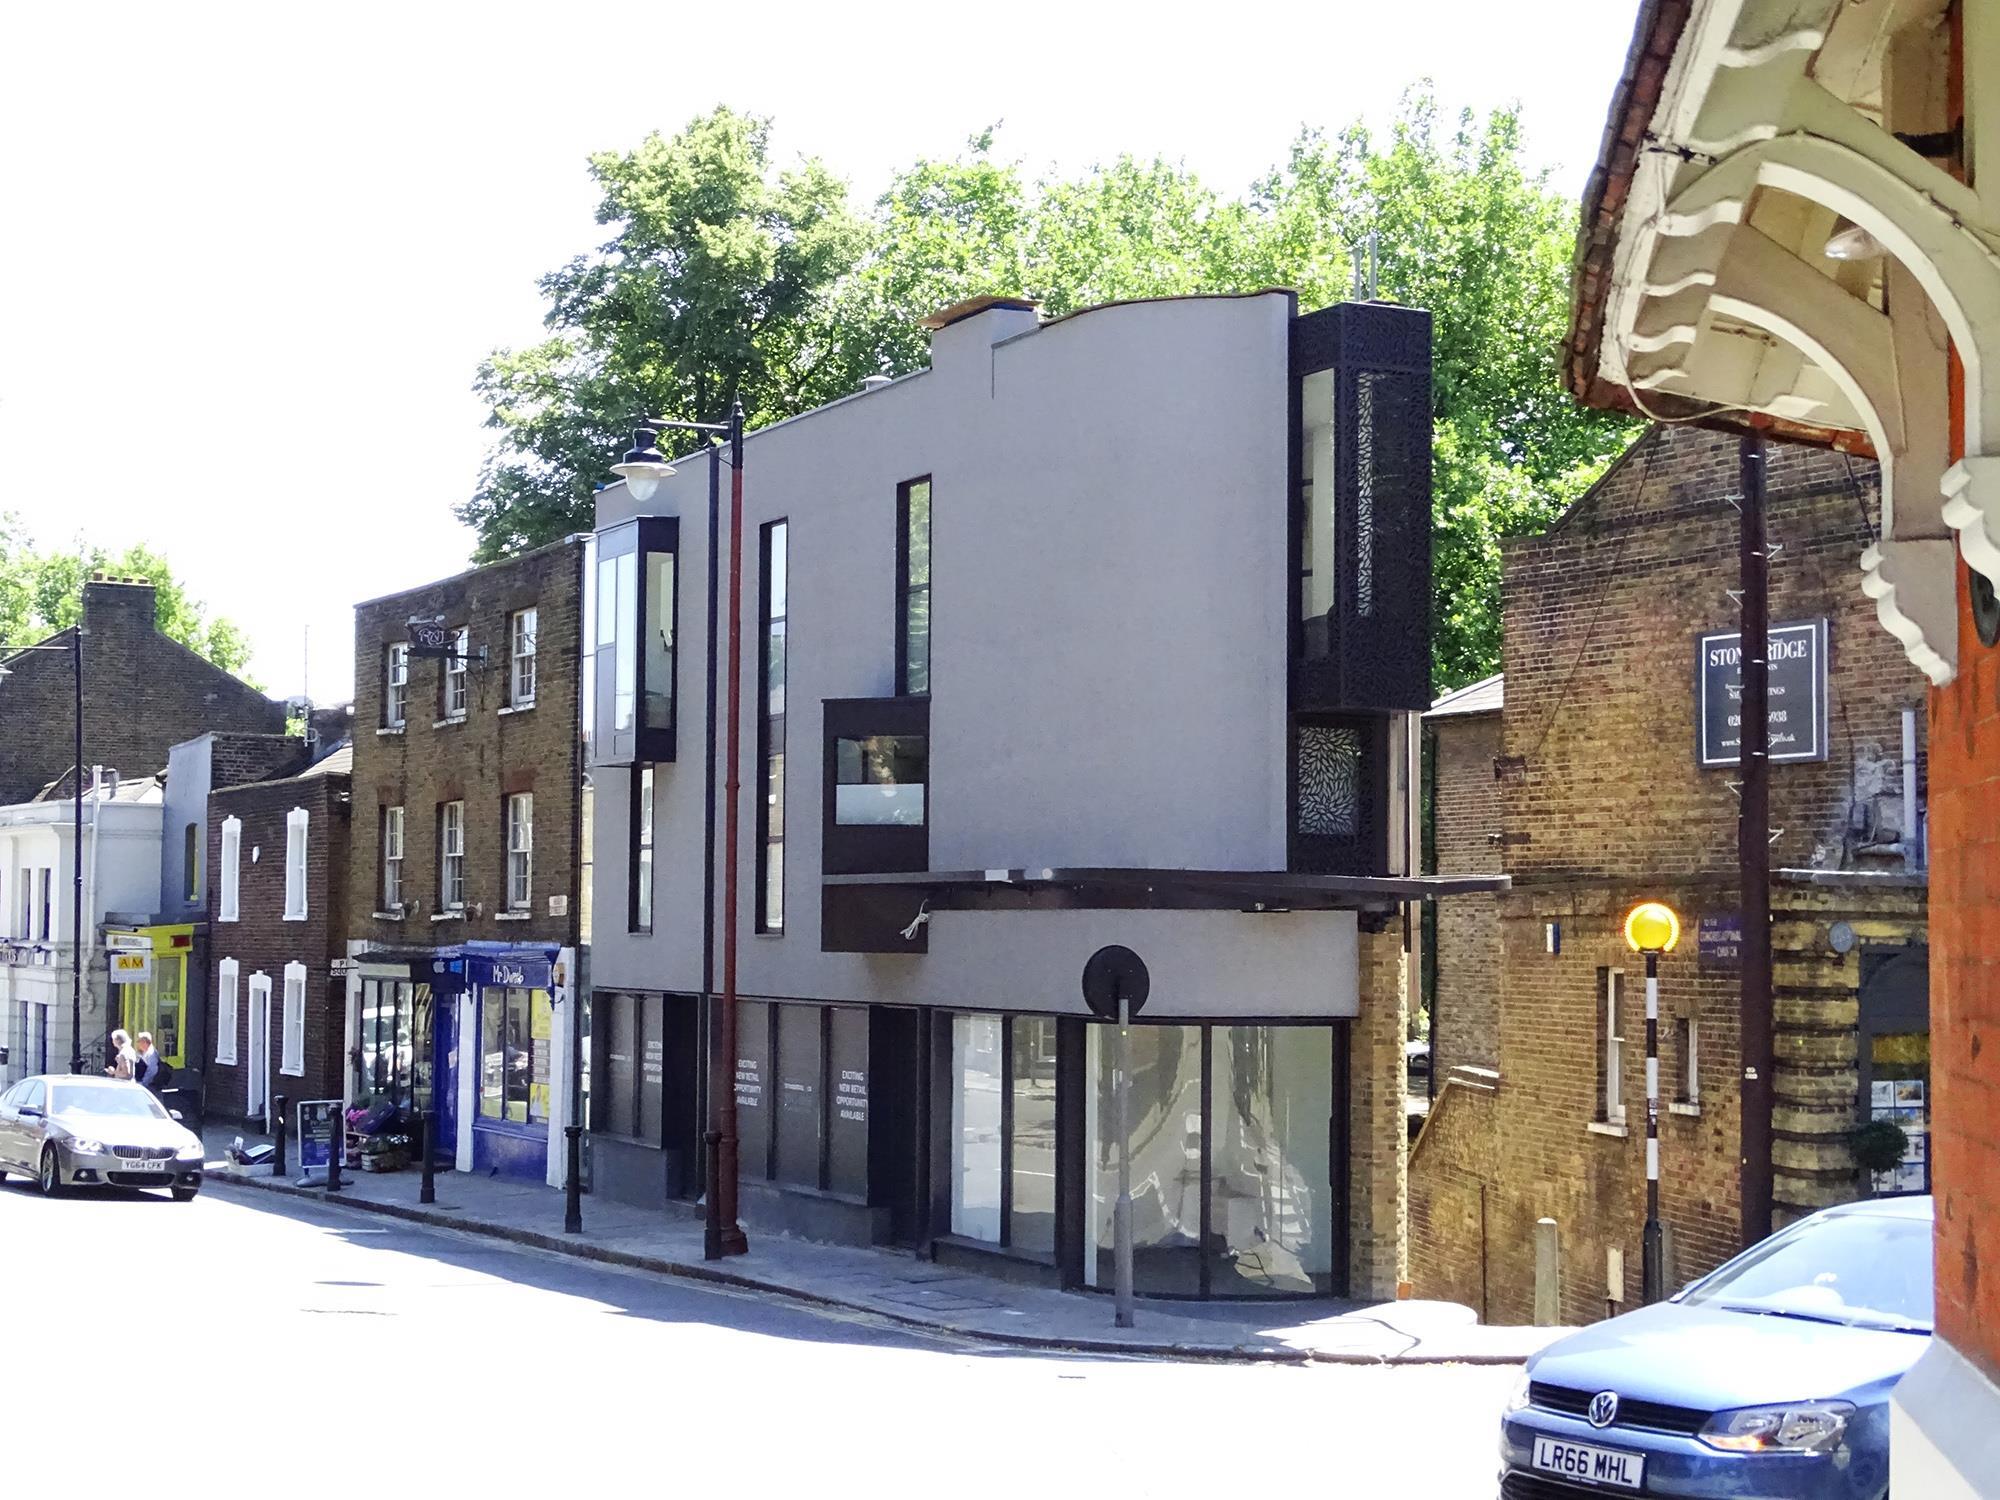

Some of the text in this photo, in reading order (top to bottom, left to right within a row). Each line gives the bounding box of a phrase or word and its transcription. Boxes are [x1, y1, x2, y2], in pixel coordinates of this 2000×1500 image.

[1710, 639, 1807, 667] STONRIDGE
[841, 1070, 865, 1081] EXCITING
[1540, 1443, 1633, 1483] LR66 MHL
